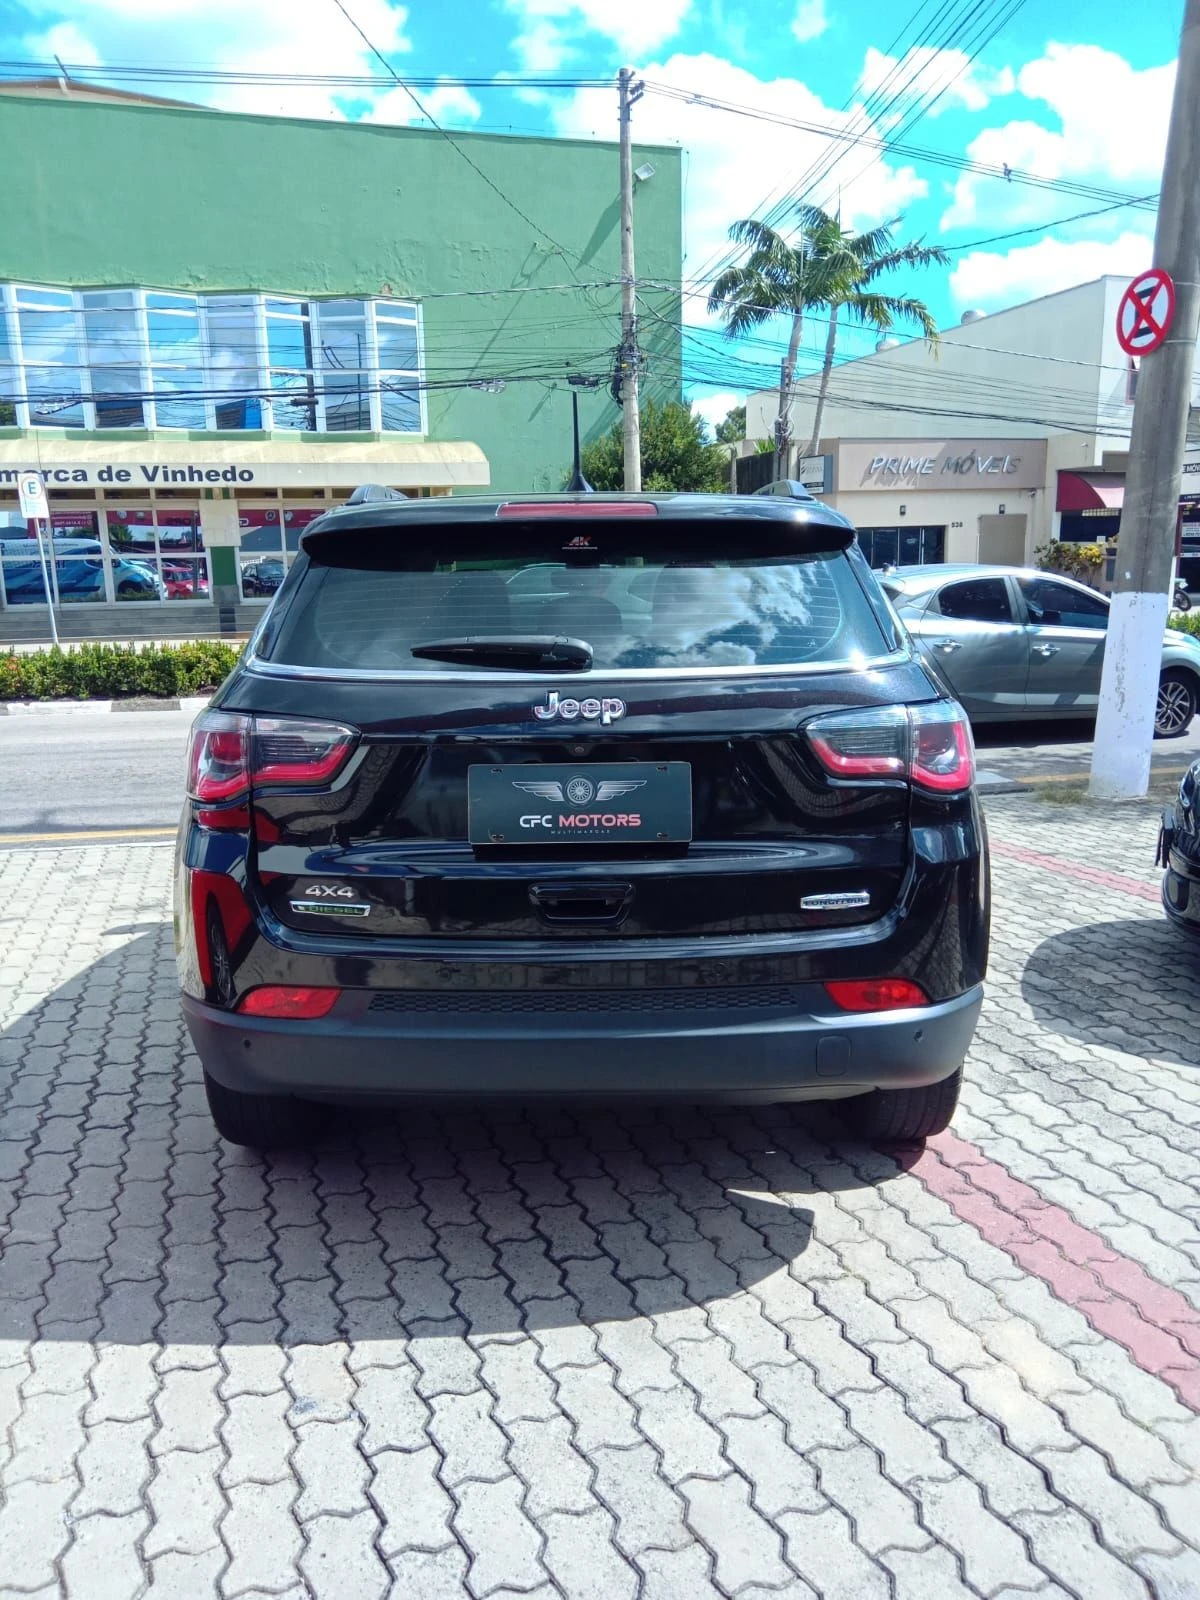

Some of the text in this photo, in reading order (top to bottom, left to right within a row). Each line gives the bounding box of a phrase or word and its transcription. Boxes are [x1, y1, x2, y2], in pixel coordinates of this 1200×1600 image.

[869, 449, 1021, 475] PRIME MÓVEIS
[0, 465, 254, 482] mrca de Vinhedo
[27, 481, 37, 495] E
[534, 691, 624, 725] Jeep
[519, 813, 642, 828] CFC MOTORS
[309, 905, 363, 914] DIESEL
